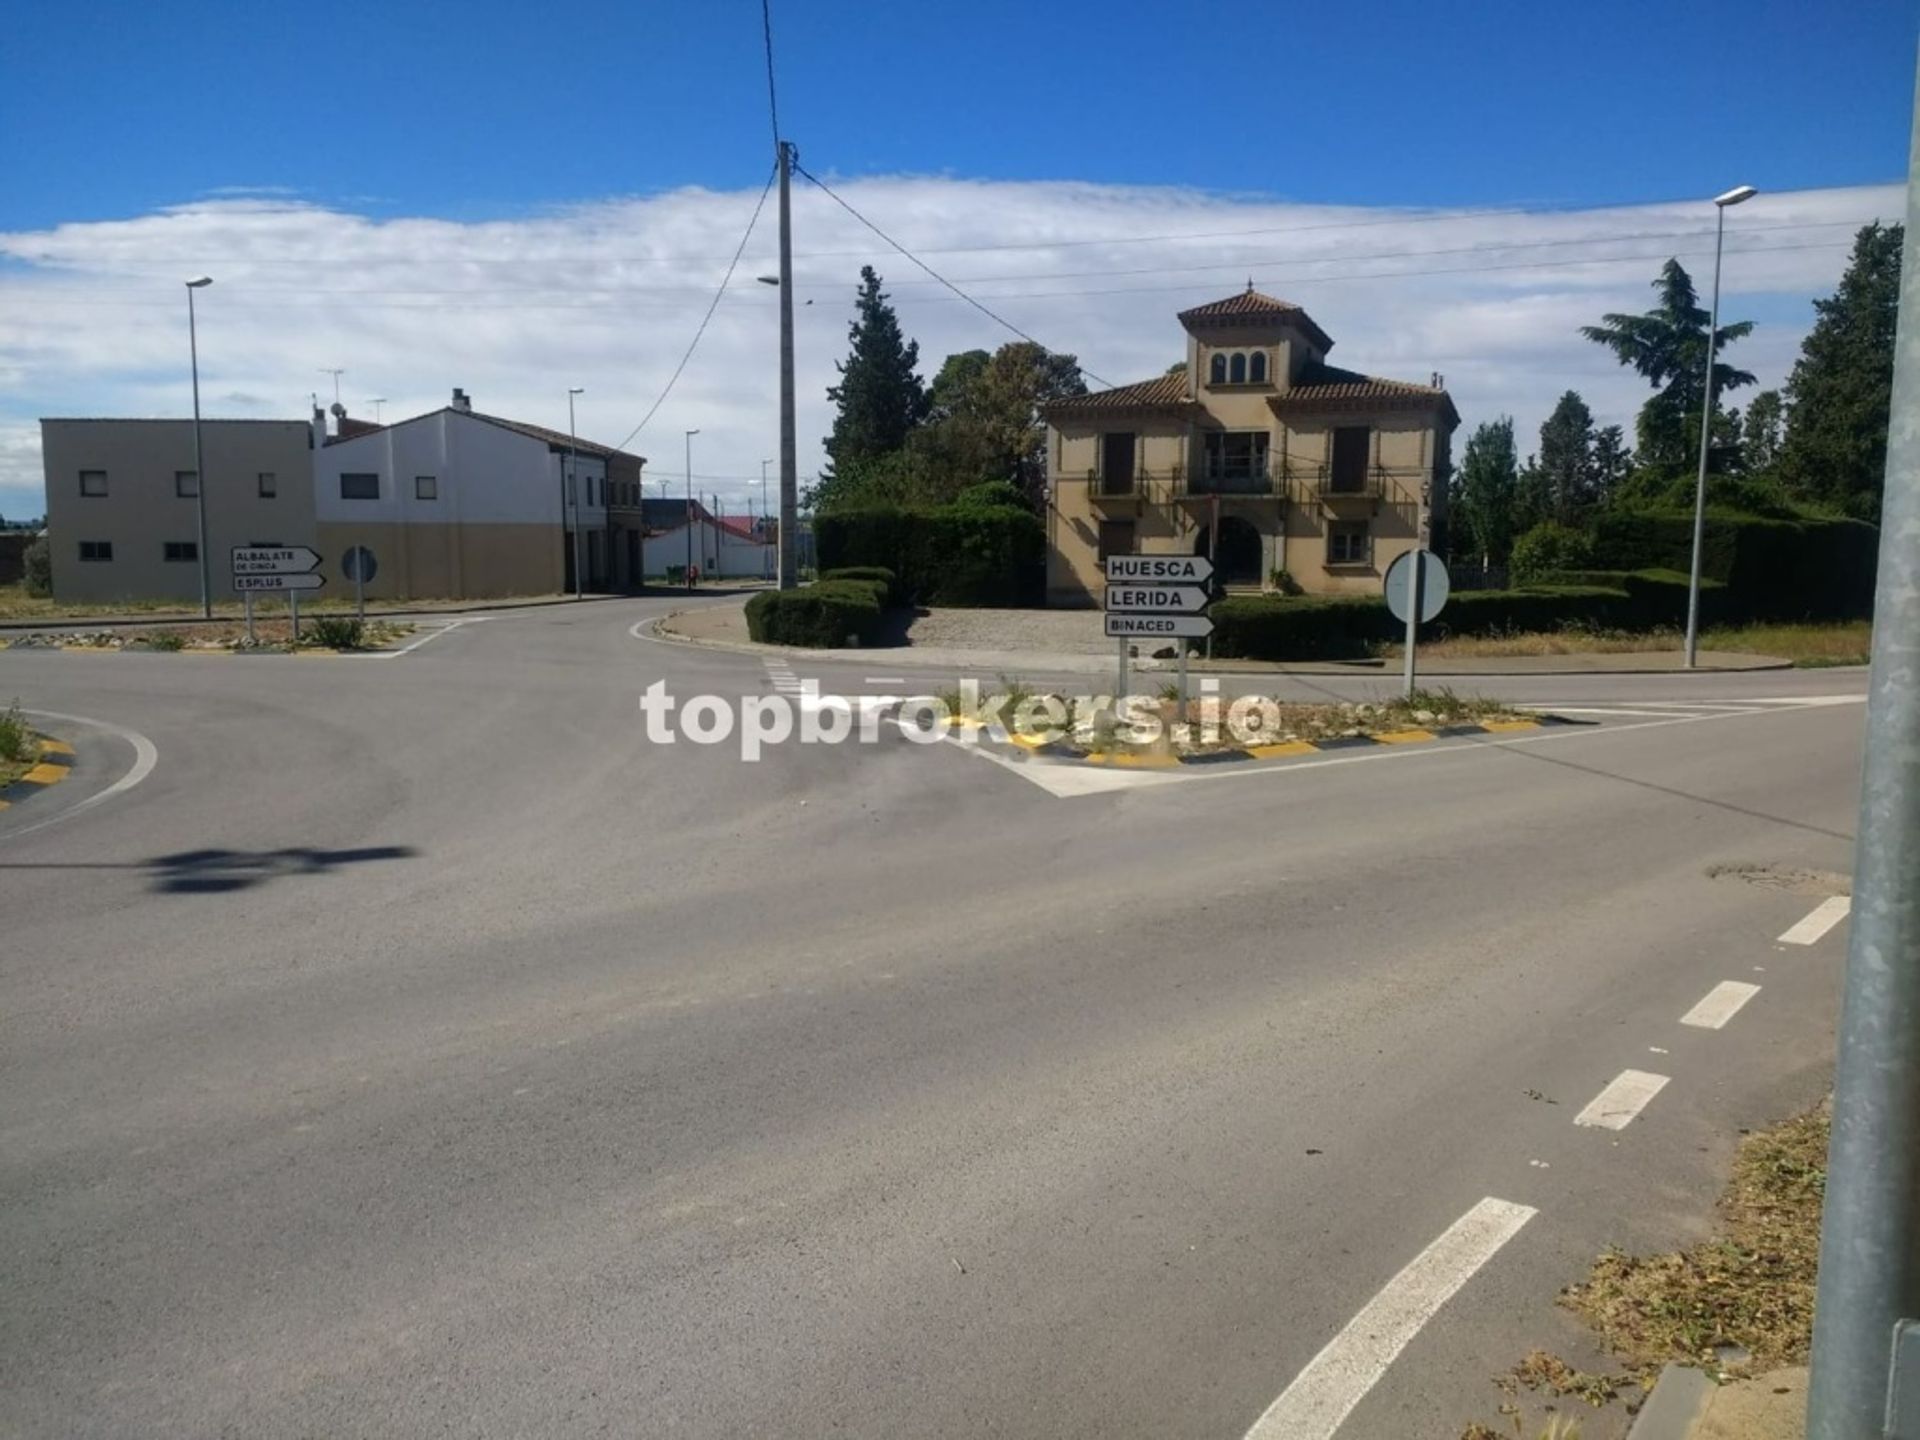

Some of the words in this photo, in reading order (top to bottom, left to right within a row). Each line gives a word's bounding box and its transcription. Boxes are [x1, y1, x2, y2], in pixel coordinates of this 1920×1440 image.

[236, 551, 294, 561] ALBALATE
[1111, 561, 1196, 577] HUESCA
[237, 578, 283, 588] ESPLUS
[1111, 591, 1183, 606] LERIDA
[1111, 620, 1175, 632] BINACED
